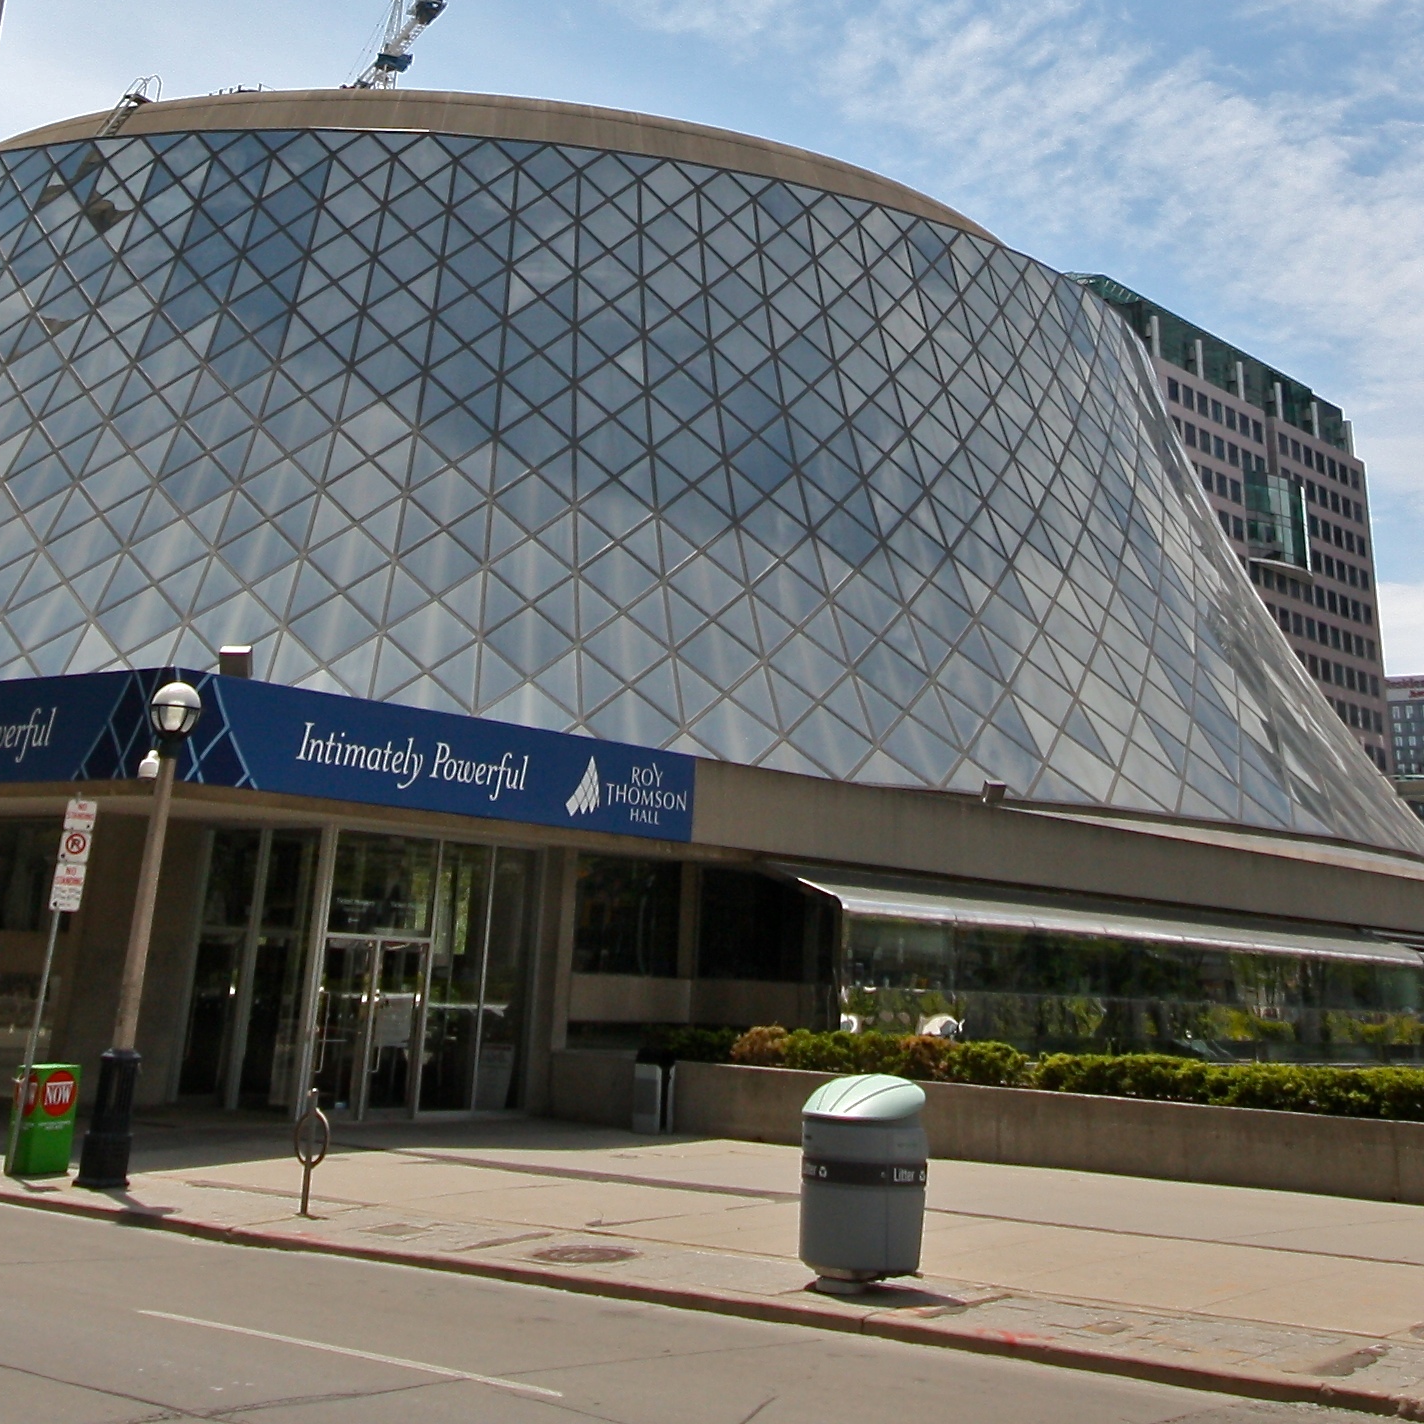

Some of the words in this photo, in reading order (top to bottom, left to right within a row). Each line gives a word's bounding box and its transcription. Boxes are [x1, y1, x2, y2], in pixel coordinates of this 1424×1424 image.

[296, 722, 423, 789] Intimately
[429, 742, 529, 802] Powerful
[631, 762, 663, 788] ROY
[606, 782, 687, 812] THOMSON
[629, 807, 660, 826] HALL
[44, 1081, 74, 1106] NOW
[893, 1167, 916, 1182] Litter
